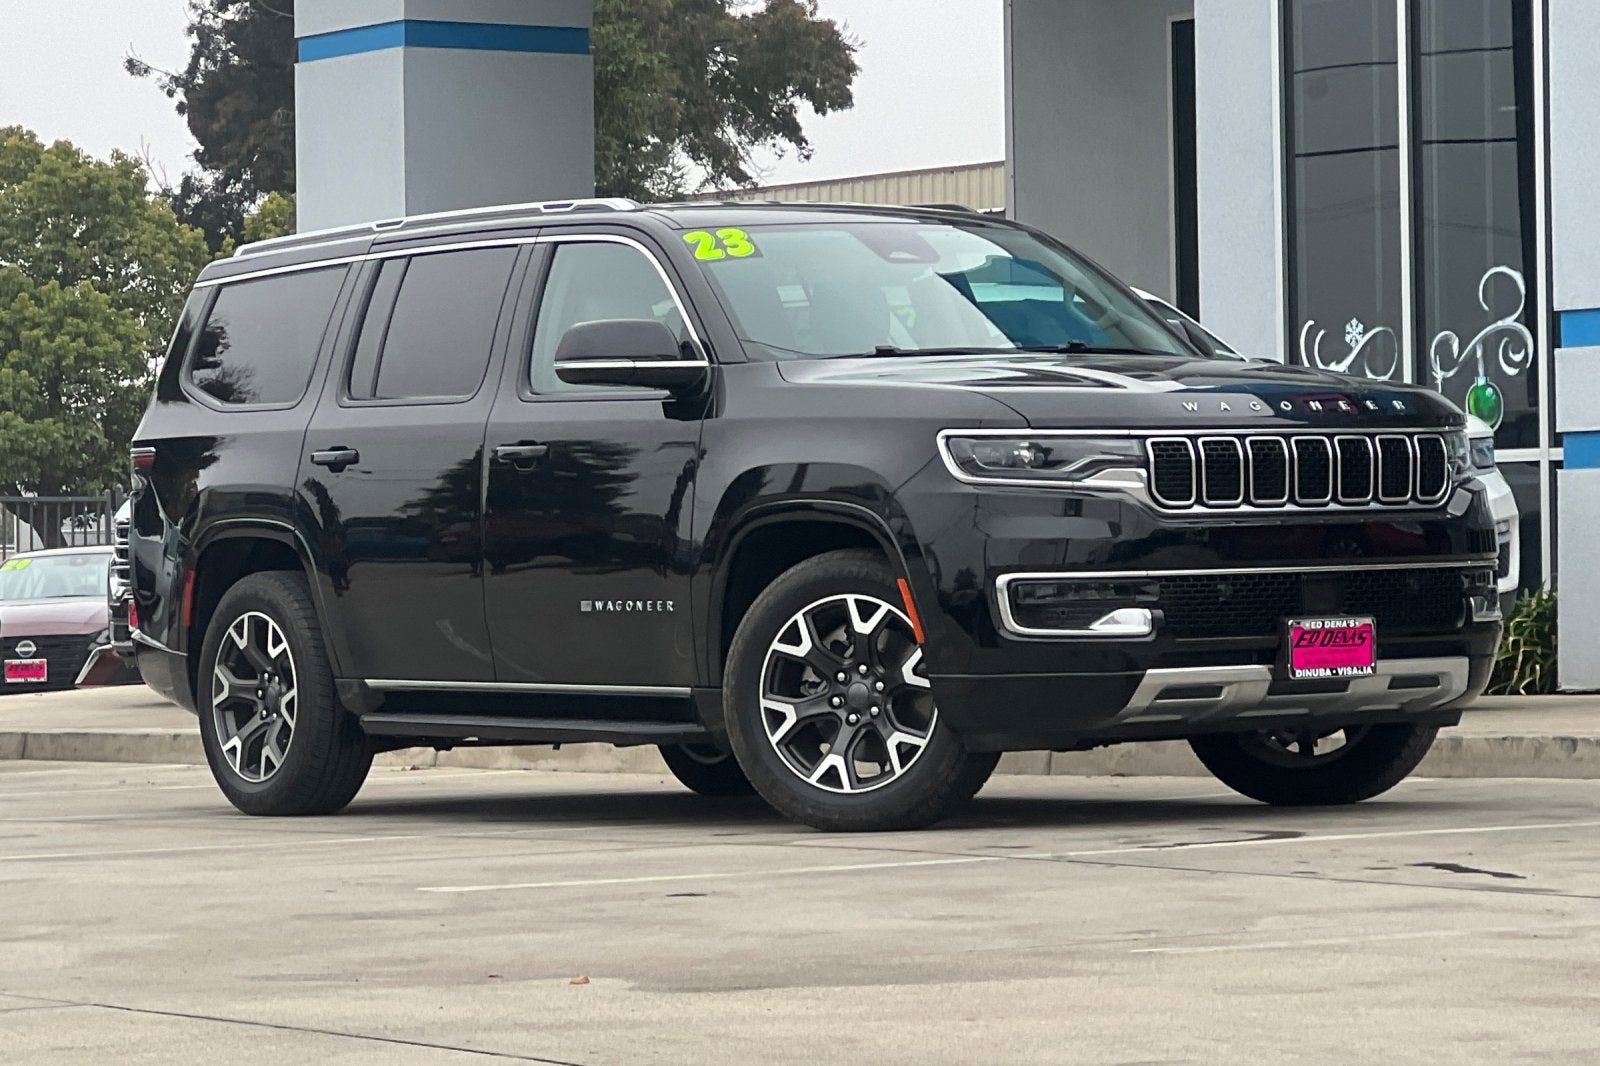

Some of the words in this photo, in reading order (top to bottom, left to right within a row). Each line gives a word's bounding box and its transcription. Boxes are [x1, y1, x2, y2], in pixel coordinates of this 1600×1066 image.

[682, 228, 755, 260] 23
[1182, 400, 1406, 413] WAGONEER
[594, 600, 674, 611] WAGONEER
[1311, 621, 1323, 629] ED
[1324, 620, 1355, 628] DENA'S
[1295, 668, 1332, 678] DINUBA
[1337, 666, 1373, 675] VISALIA
